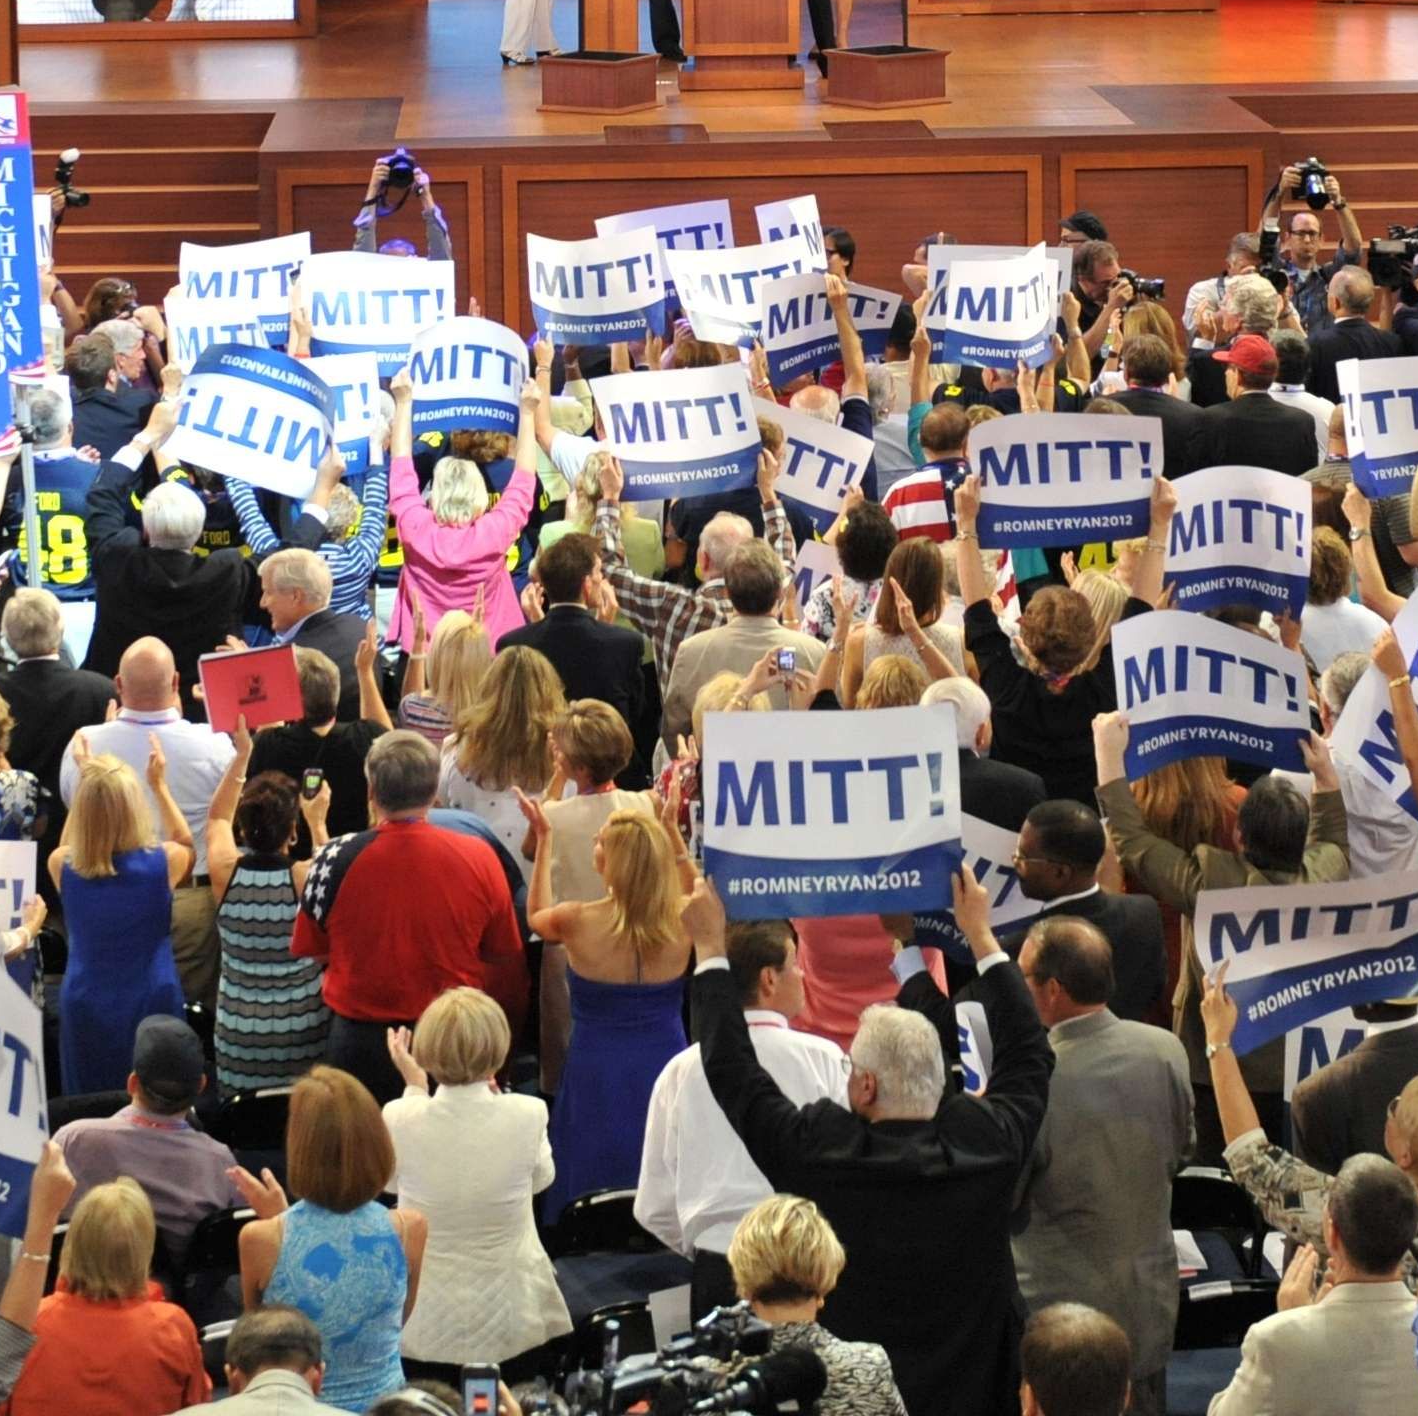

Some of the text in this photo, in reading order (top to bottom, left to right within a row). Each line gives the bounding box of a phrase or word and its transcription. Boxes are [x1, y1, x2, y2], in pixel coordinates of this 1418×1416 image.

[657, 222, 726, 251] TT!
[186, 261, 303, 300] MITT
[535, 253, 657, 300] MITT!
[312, 289, 445, 327] MITT!
[544, 318, 647, 334] #ROMNEYRYAN2012
[779, 341, 841, 372] #ROMNEYRYAN
[178, 388, 323, 470] MITT!
[413, 405, 516, 424] #ROMNEYRYAN2012
[609, 392, 748, 444] MITT!
[629, 463, 741, 486] #ROMNEYRYAN2012
[784, 437, 858, 498] TT!
[978, 440, 1153, 487] MITT!
[202, 530, 230, 545] FORD
[993, 514, 1133, 533] #ROMNEYRYAN2012
[1169, 498, 1304, 558] MITT!
[1178, 576, 1290, 601] #ROMNEYRYAN2012
[1124, 645, 1300, 713] MITT!
[1137, 728, 1274, 757] #ROMNEYRYAN2012
[714, 752, 945, 827] MITT!
[728, 870, 922, 896] #ROMNEYRYAN2012
[1246, 955, 1417, 1022] #ROMNEYRYAN2012
